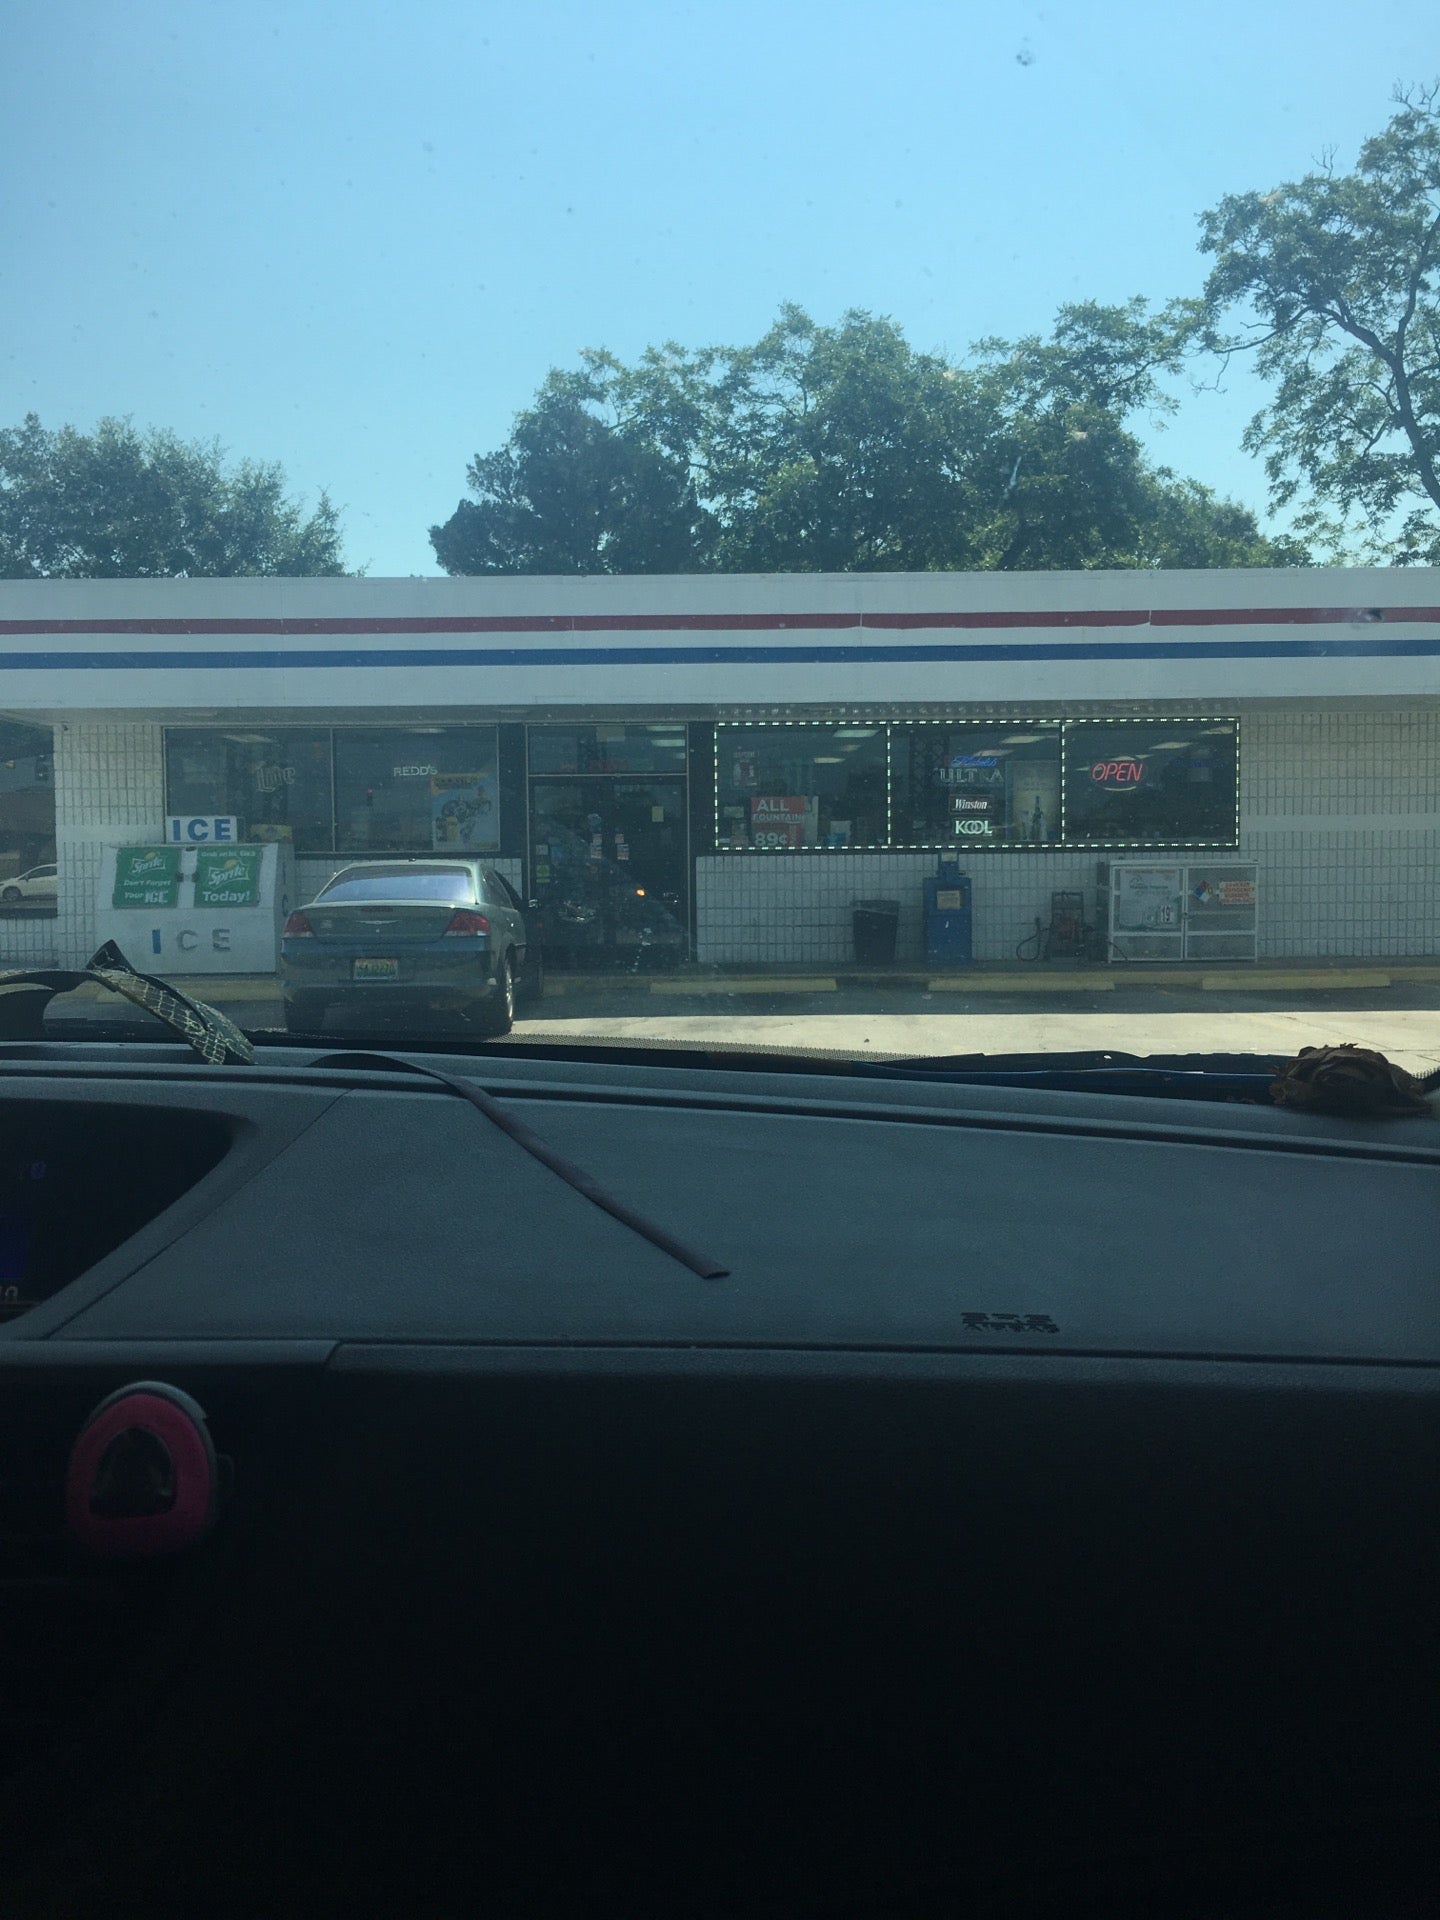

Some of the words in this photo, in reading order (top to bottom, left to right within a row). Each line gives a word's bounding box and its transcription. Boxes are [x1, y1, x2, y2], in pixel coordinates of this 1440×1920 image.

[1091, 762, 1143, 782] OPEN
[756, 799, 790, 812] ALL
[954, 798, 988, 810] Winston
[172, 818, 232, 841] ICE
[955, 820, 993, 834] KOOL
[131, 856, 164, 874] Sprite
[208, 863, 246, 885] Sprite
[144, 890, 169, 903] ICE
[202, 890, 250, 903] Today!
[152, 929, 231, 955] ICE
